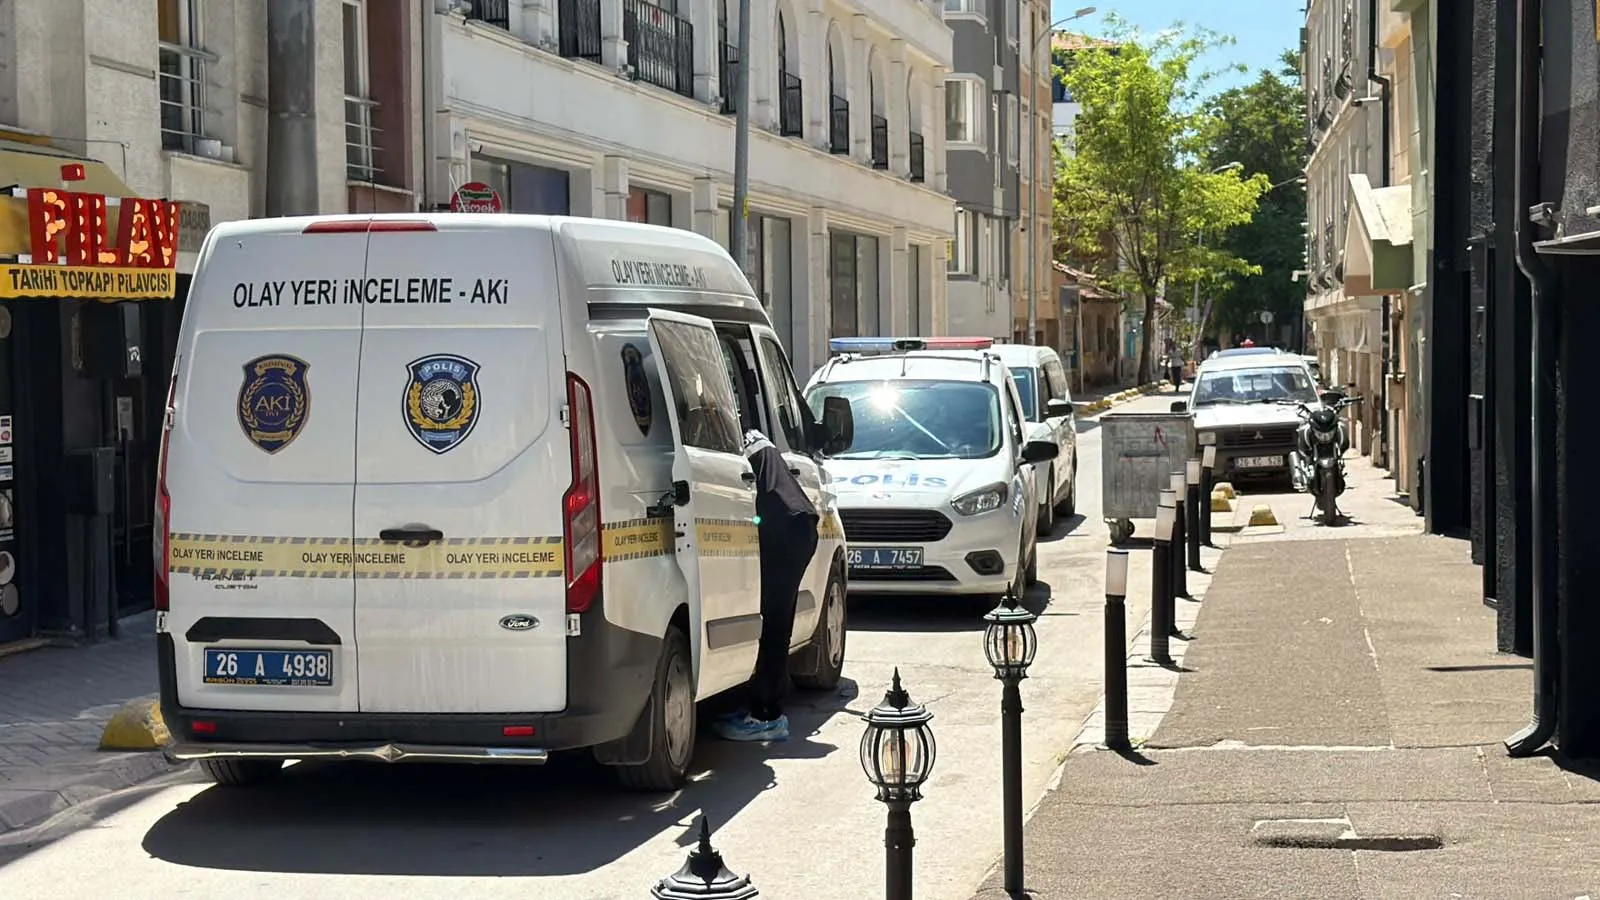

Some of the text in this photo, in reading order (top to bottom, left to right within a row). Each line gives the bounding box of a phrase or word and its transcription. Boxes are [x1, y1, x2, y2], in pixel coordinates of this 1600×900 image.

[612, 259, 635, 284] OLAY
[60, 271, 114, 292] TOPKAPI
[233, 281, 285, 308] OLAY
[172, 547, 194, 559] OLAY
[302, 552, 327, 564] OLAY
[446, 553, 473, 564] OLAY
[848, 550, 921, 564] 26 A 7457
[507, 617, 530, 628] Ford
[216, 653, 328, 677] 26 A 4938
